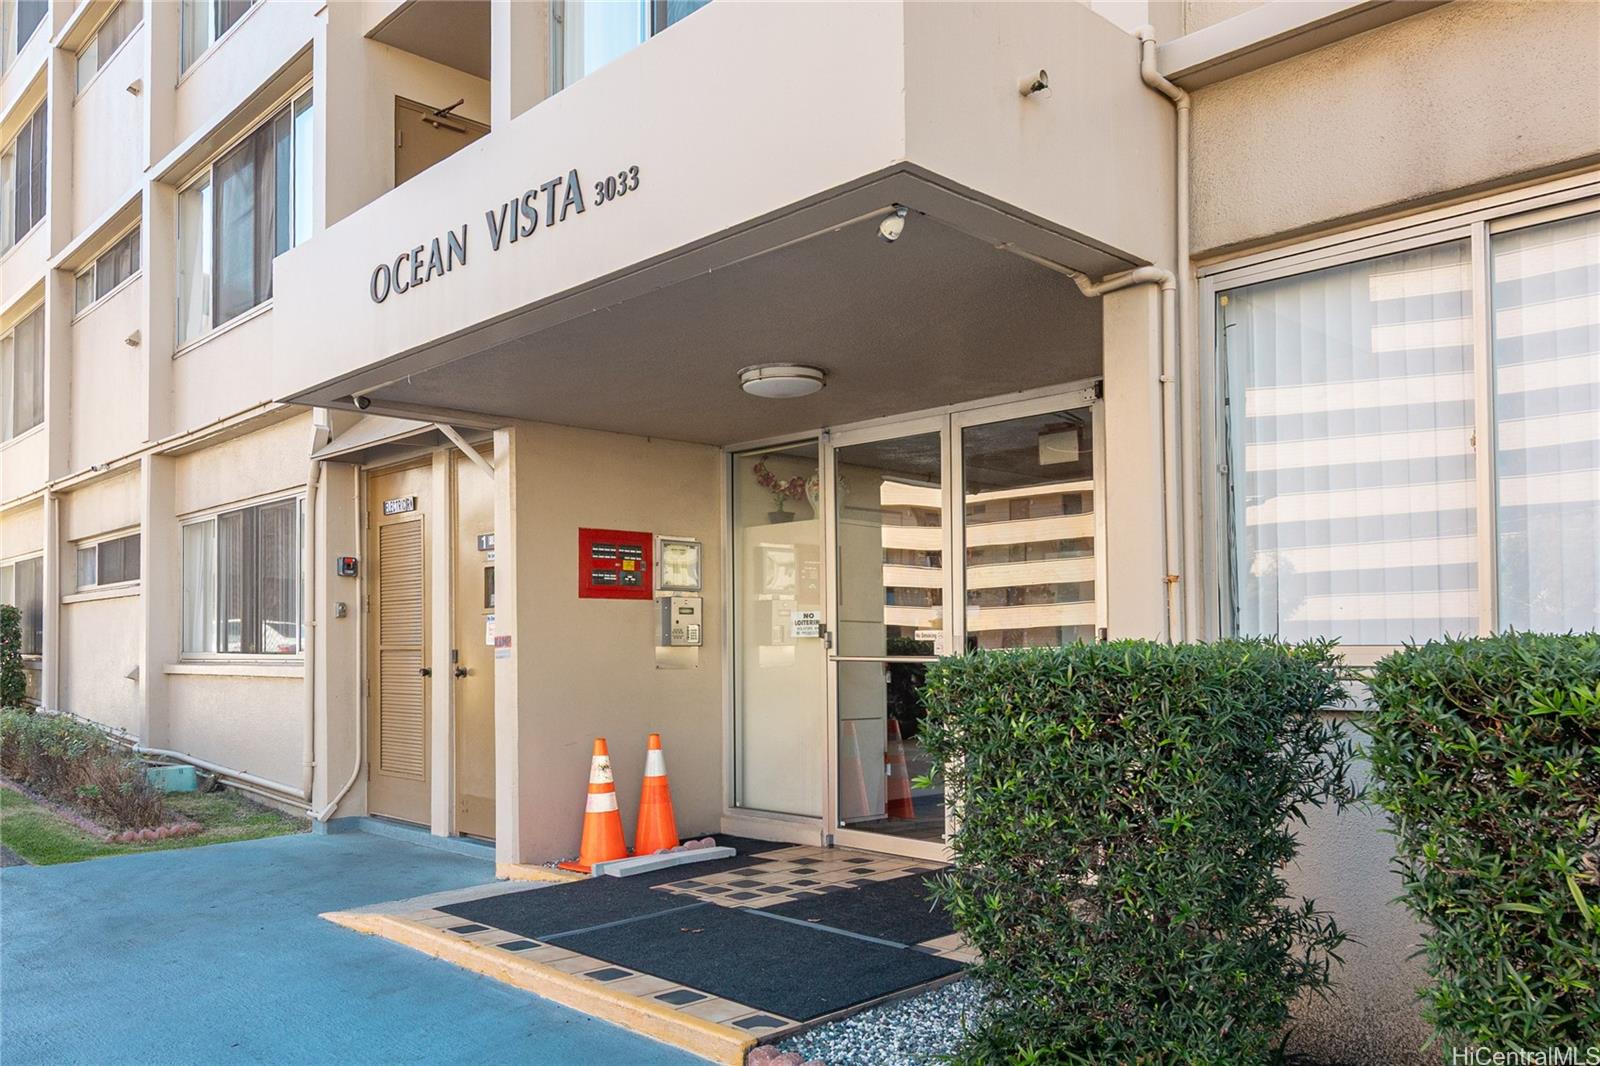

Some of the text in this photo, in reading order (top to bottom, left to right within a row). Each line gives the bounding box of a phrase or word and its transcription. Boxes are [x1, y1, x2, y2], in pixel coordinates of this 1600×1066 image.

[370, 165, 640, 304] OCEAN VISTA 3033
